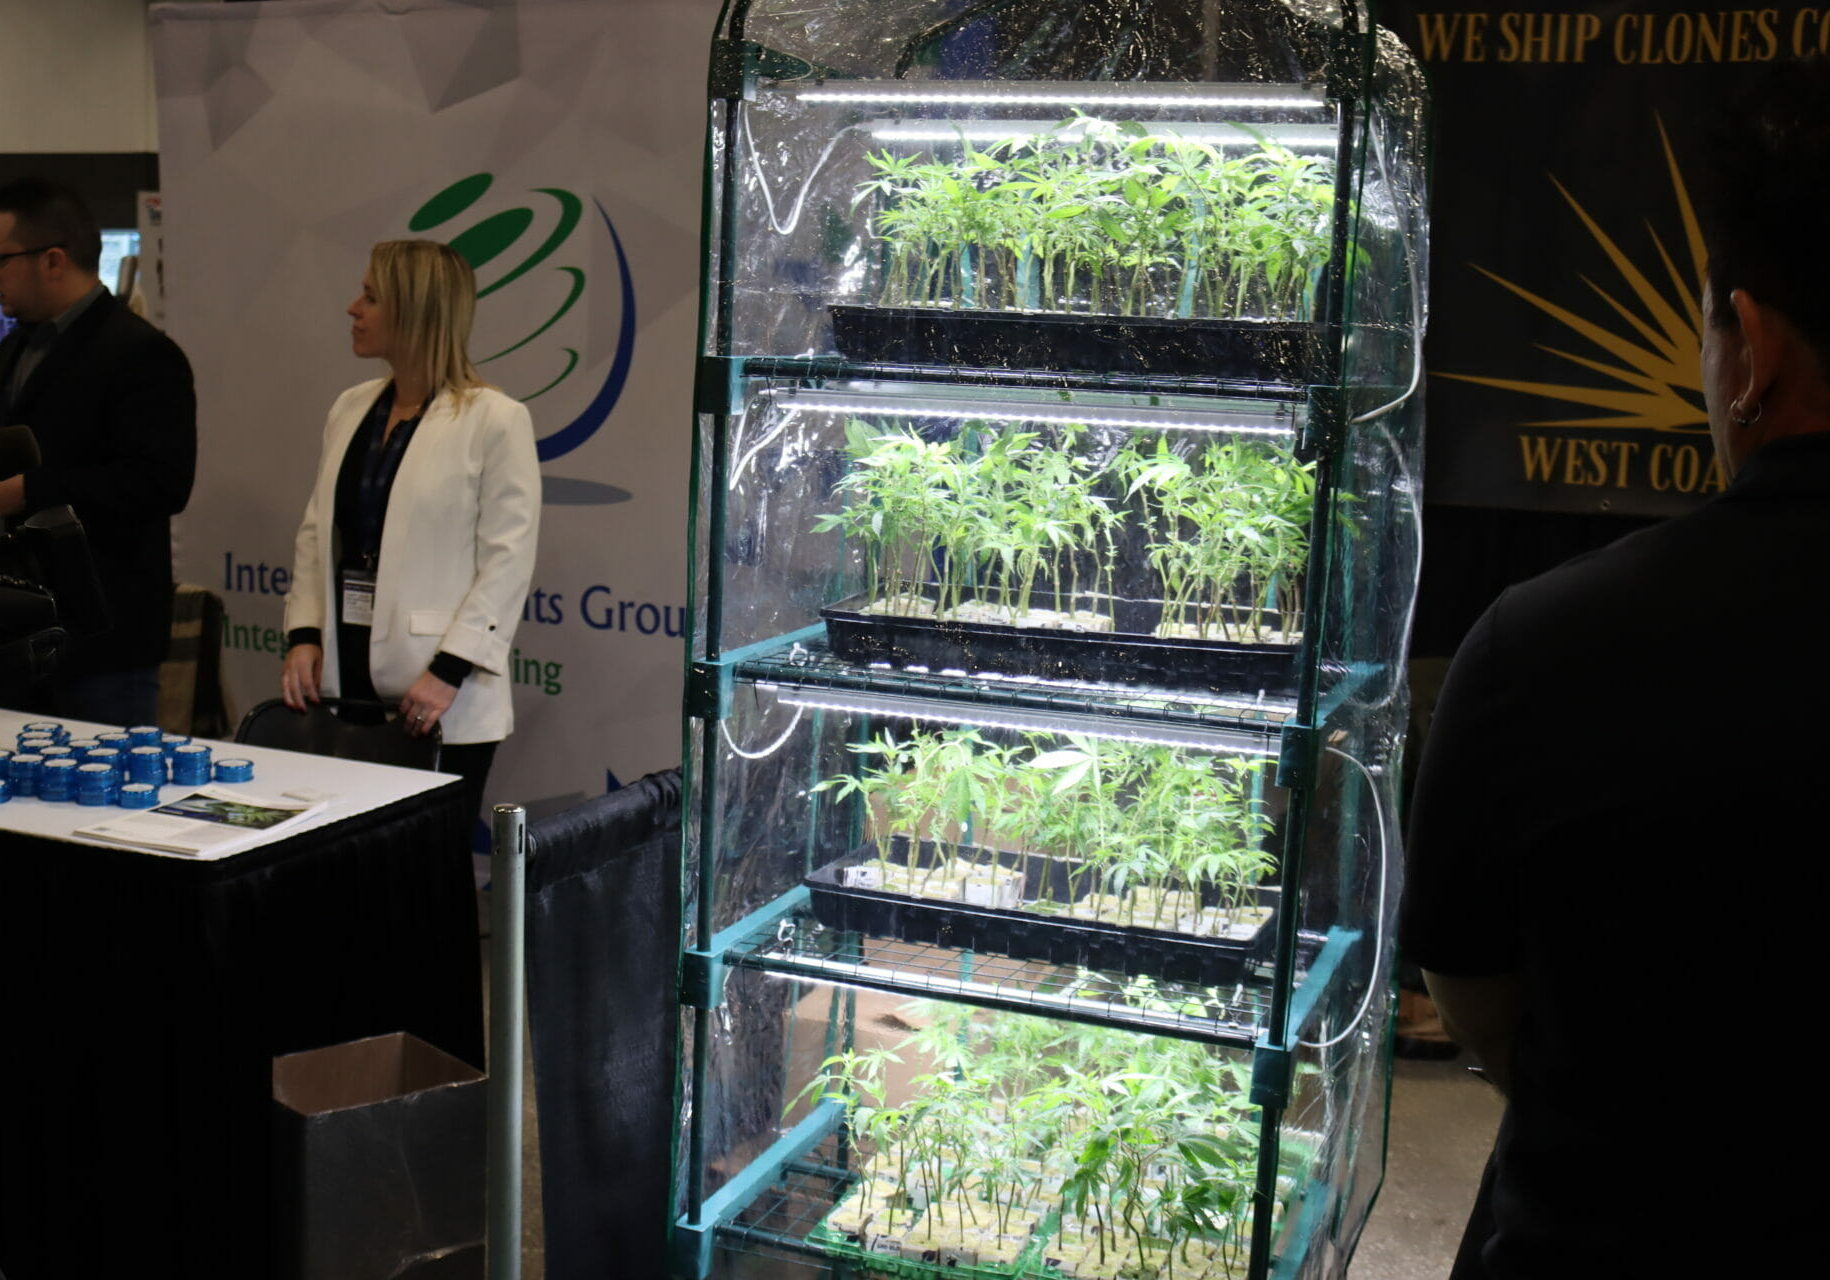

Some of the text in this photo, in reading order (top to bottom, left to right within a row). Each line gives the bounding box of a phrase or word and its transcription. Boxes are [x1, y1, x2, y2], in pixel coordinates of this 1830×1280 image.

[1416, 12, 1488, 64] WE
[1499, 12, 1601, 64] SHIP
[1613, 8, 1779, 65] CLONES
[1519, 435, 1728, 493] WEST COA
[224, 551, 293, 597] Inte
[580, 584, 688, 639] Grou
[512, 648, 564, 696] ing
